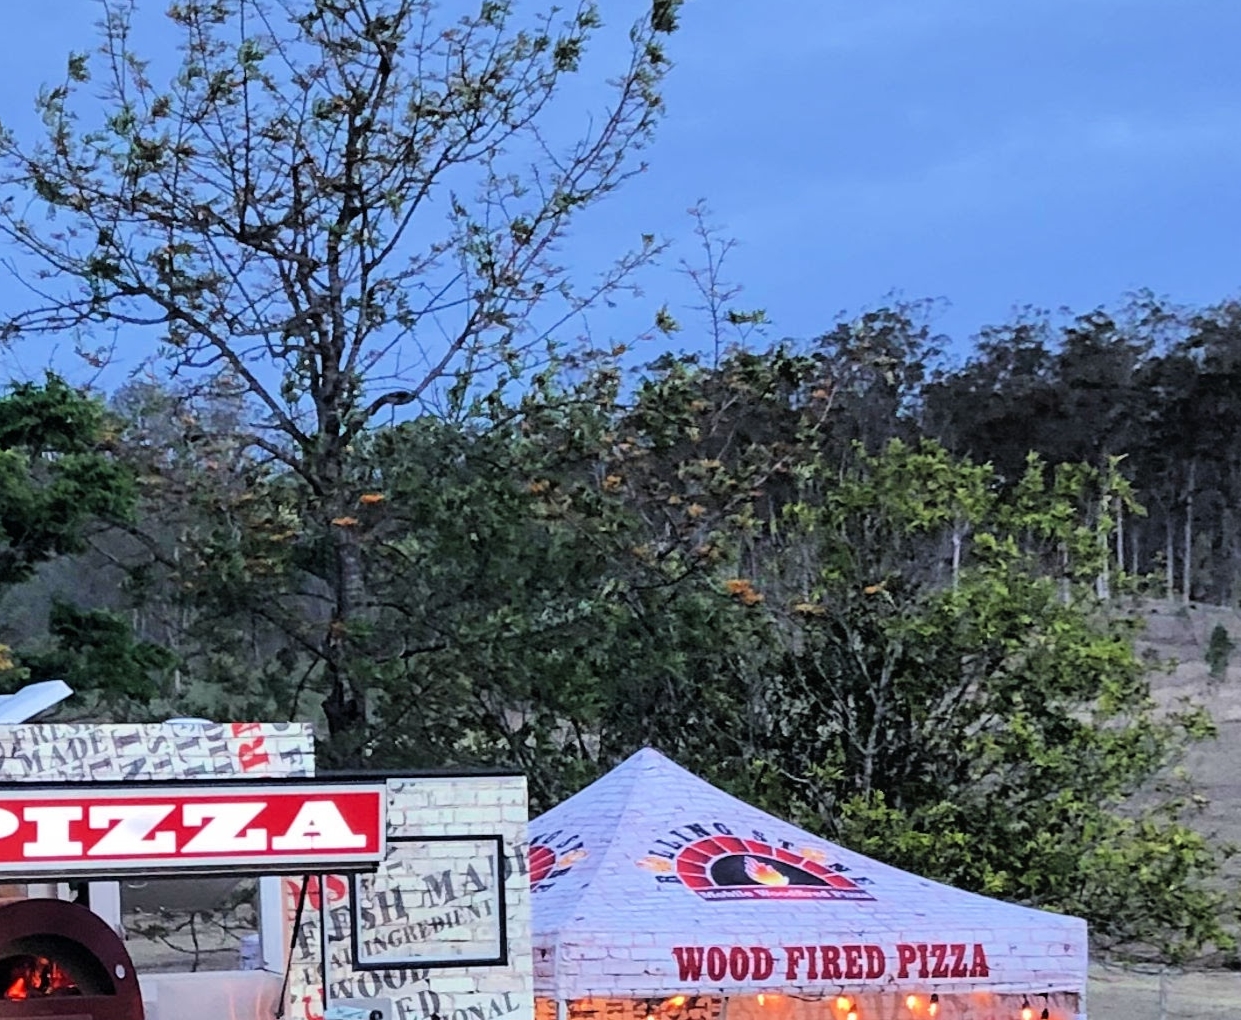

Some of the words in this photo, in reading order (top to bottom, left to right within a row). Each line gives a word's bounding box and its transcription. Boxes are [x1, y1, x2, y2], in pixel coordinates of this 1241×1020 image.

[672, 947, 775, 981] WOOD
[784, 946, 887, 980] FIRED
[896, 944, 990, 979] PIZZA
